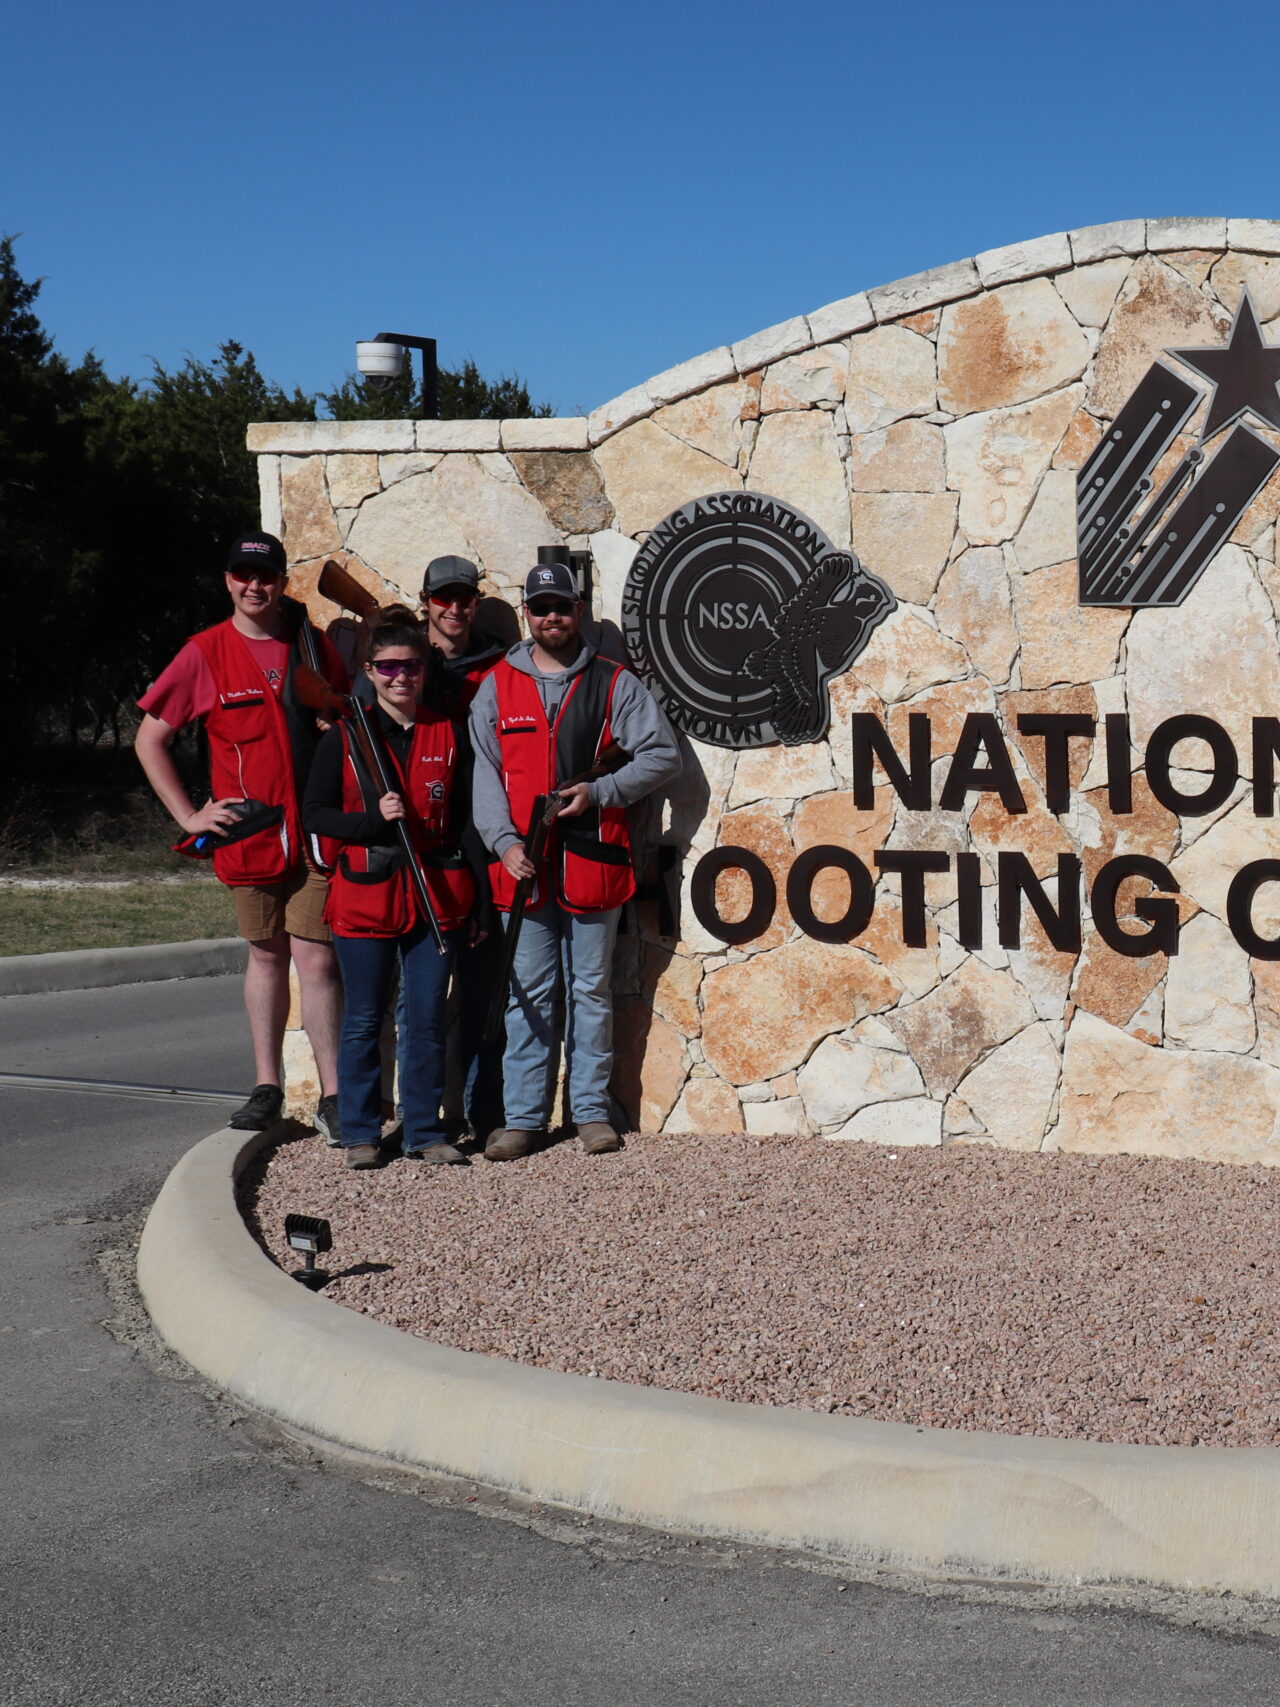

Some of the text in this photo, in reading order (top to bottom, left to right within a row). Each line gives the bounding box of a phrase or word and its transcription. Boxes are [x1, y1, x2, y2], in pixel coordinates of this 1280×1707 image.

[623, 510, 690, 616] SHOOTING
[691, 494, 826, 559] ASSOCIATION
[699, 602, 770, 629] NSSA
[617, 844, 1180, 957] HOOTING
